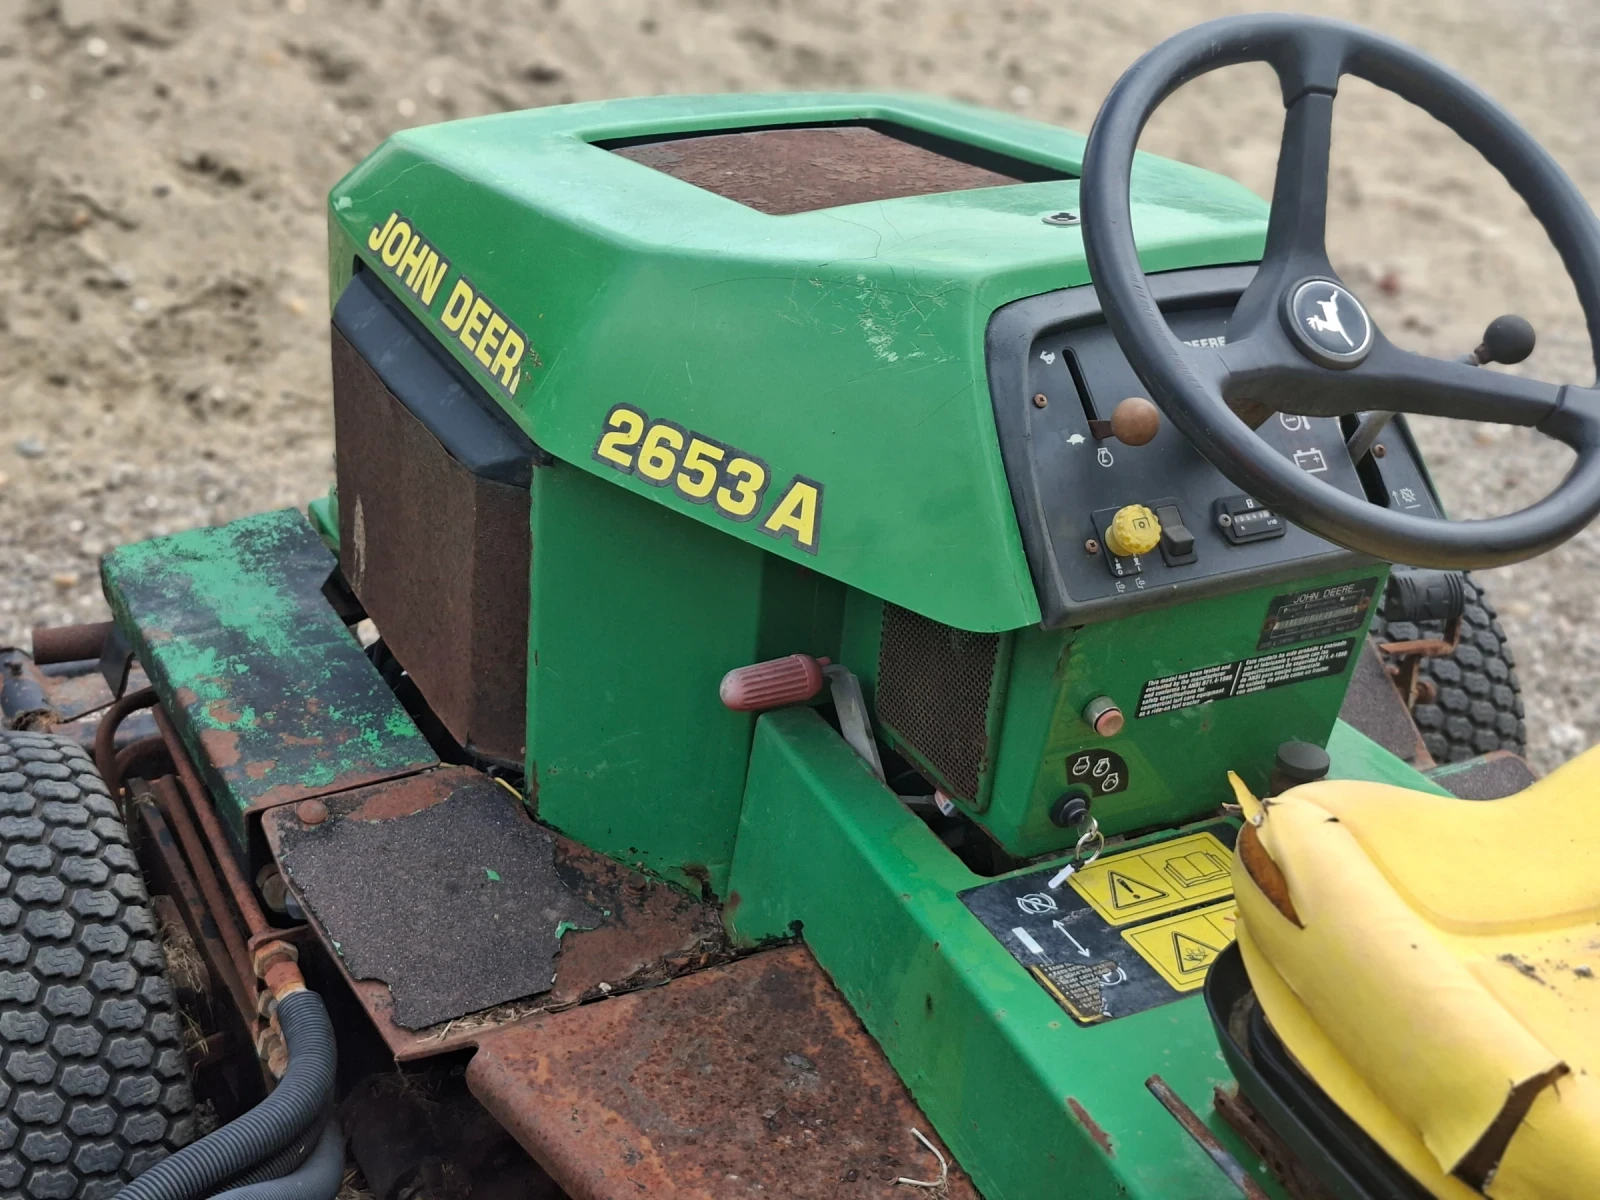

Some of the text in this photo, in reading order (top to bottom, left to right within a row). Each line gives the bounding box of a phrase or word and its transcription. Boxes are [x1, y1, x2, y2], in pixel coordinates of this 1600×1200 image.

[368, 212, 448, 306] JOHN
[597, 408, 818, 546] 2653 A
[1294, 592, 1319, 604] JOHN
[1323, 584, 1355, 598] DEERE
[1203, 666, 1220, 674] tested
[1146, 683, 1172, 693] evaluated
[1140, 699, 1172, 711] commercial
[1196, 688, 1225, 698] equipment
[1142, 697, 1158, 705] safety
